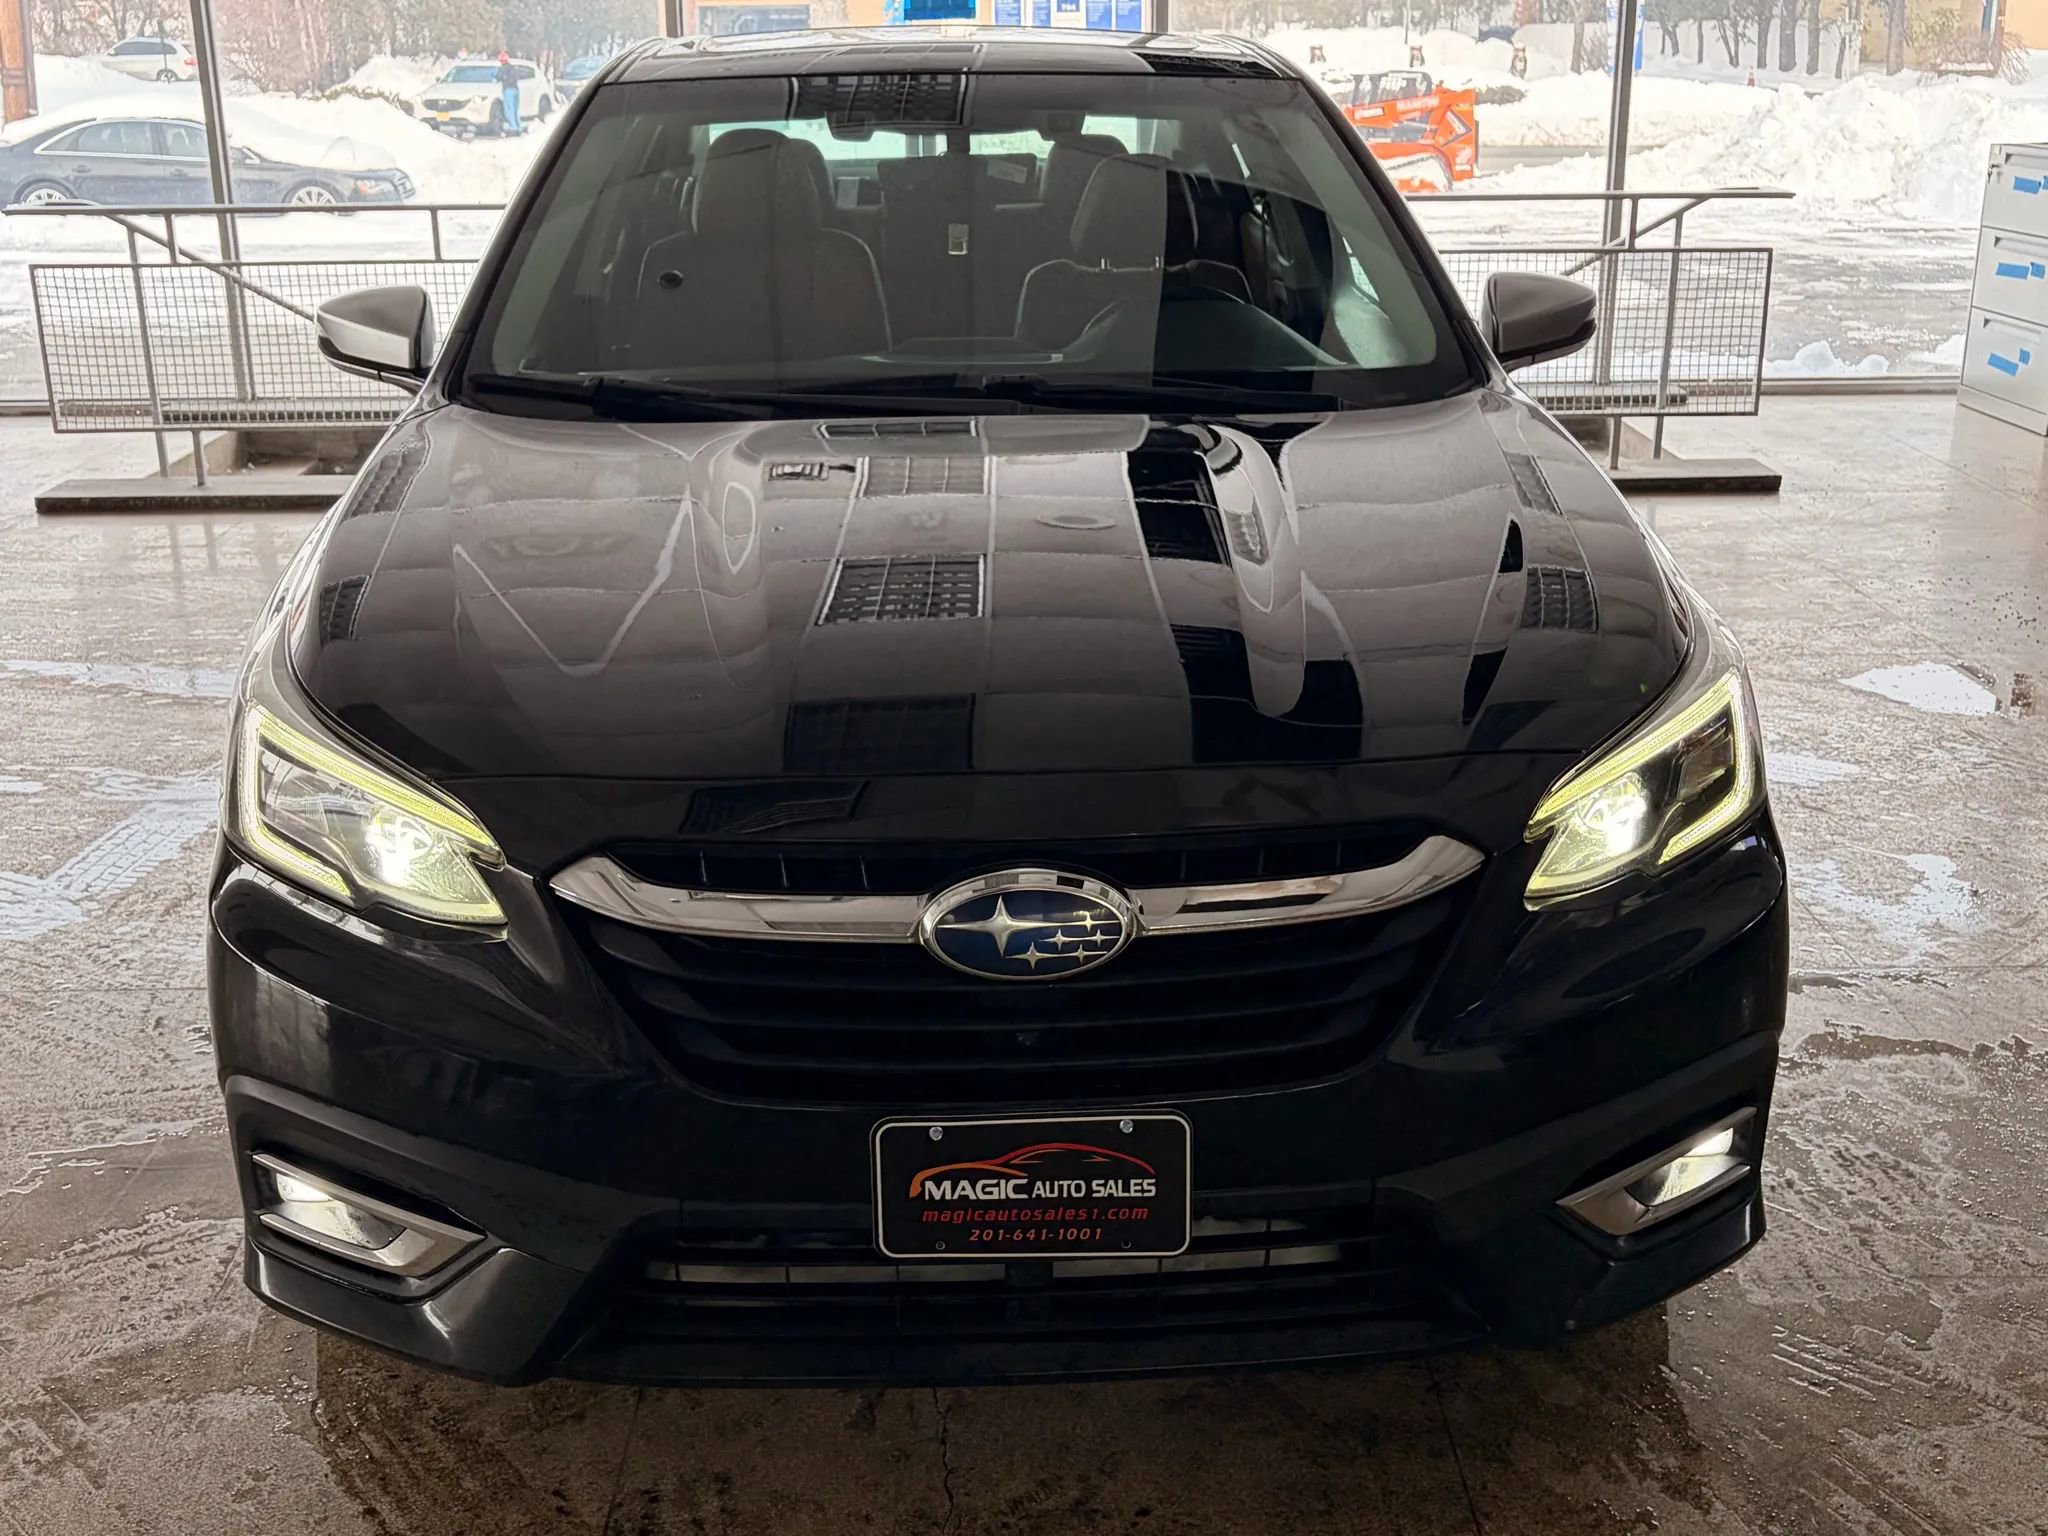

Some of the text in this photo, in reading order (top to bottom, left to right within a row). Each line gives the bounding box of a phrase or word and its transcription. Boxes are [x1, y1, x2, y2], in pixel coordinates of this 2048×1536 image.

[925, 1179, 1156, 1200] MAGIC AUTO SALES
[922, 1207, 1148, 1222] magicautosales1.com
[969, 1228, 1102, 1241] 201-641-1001
